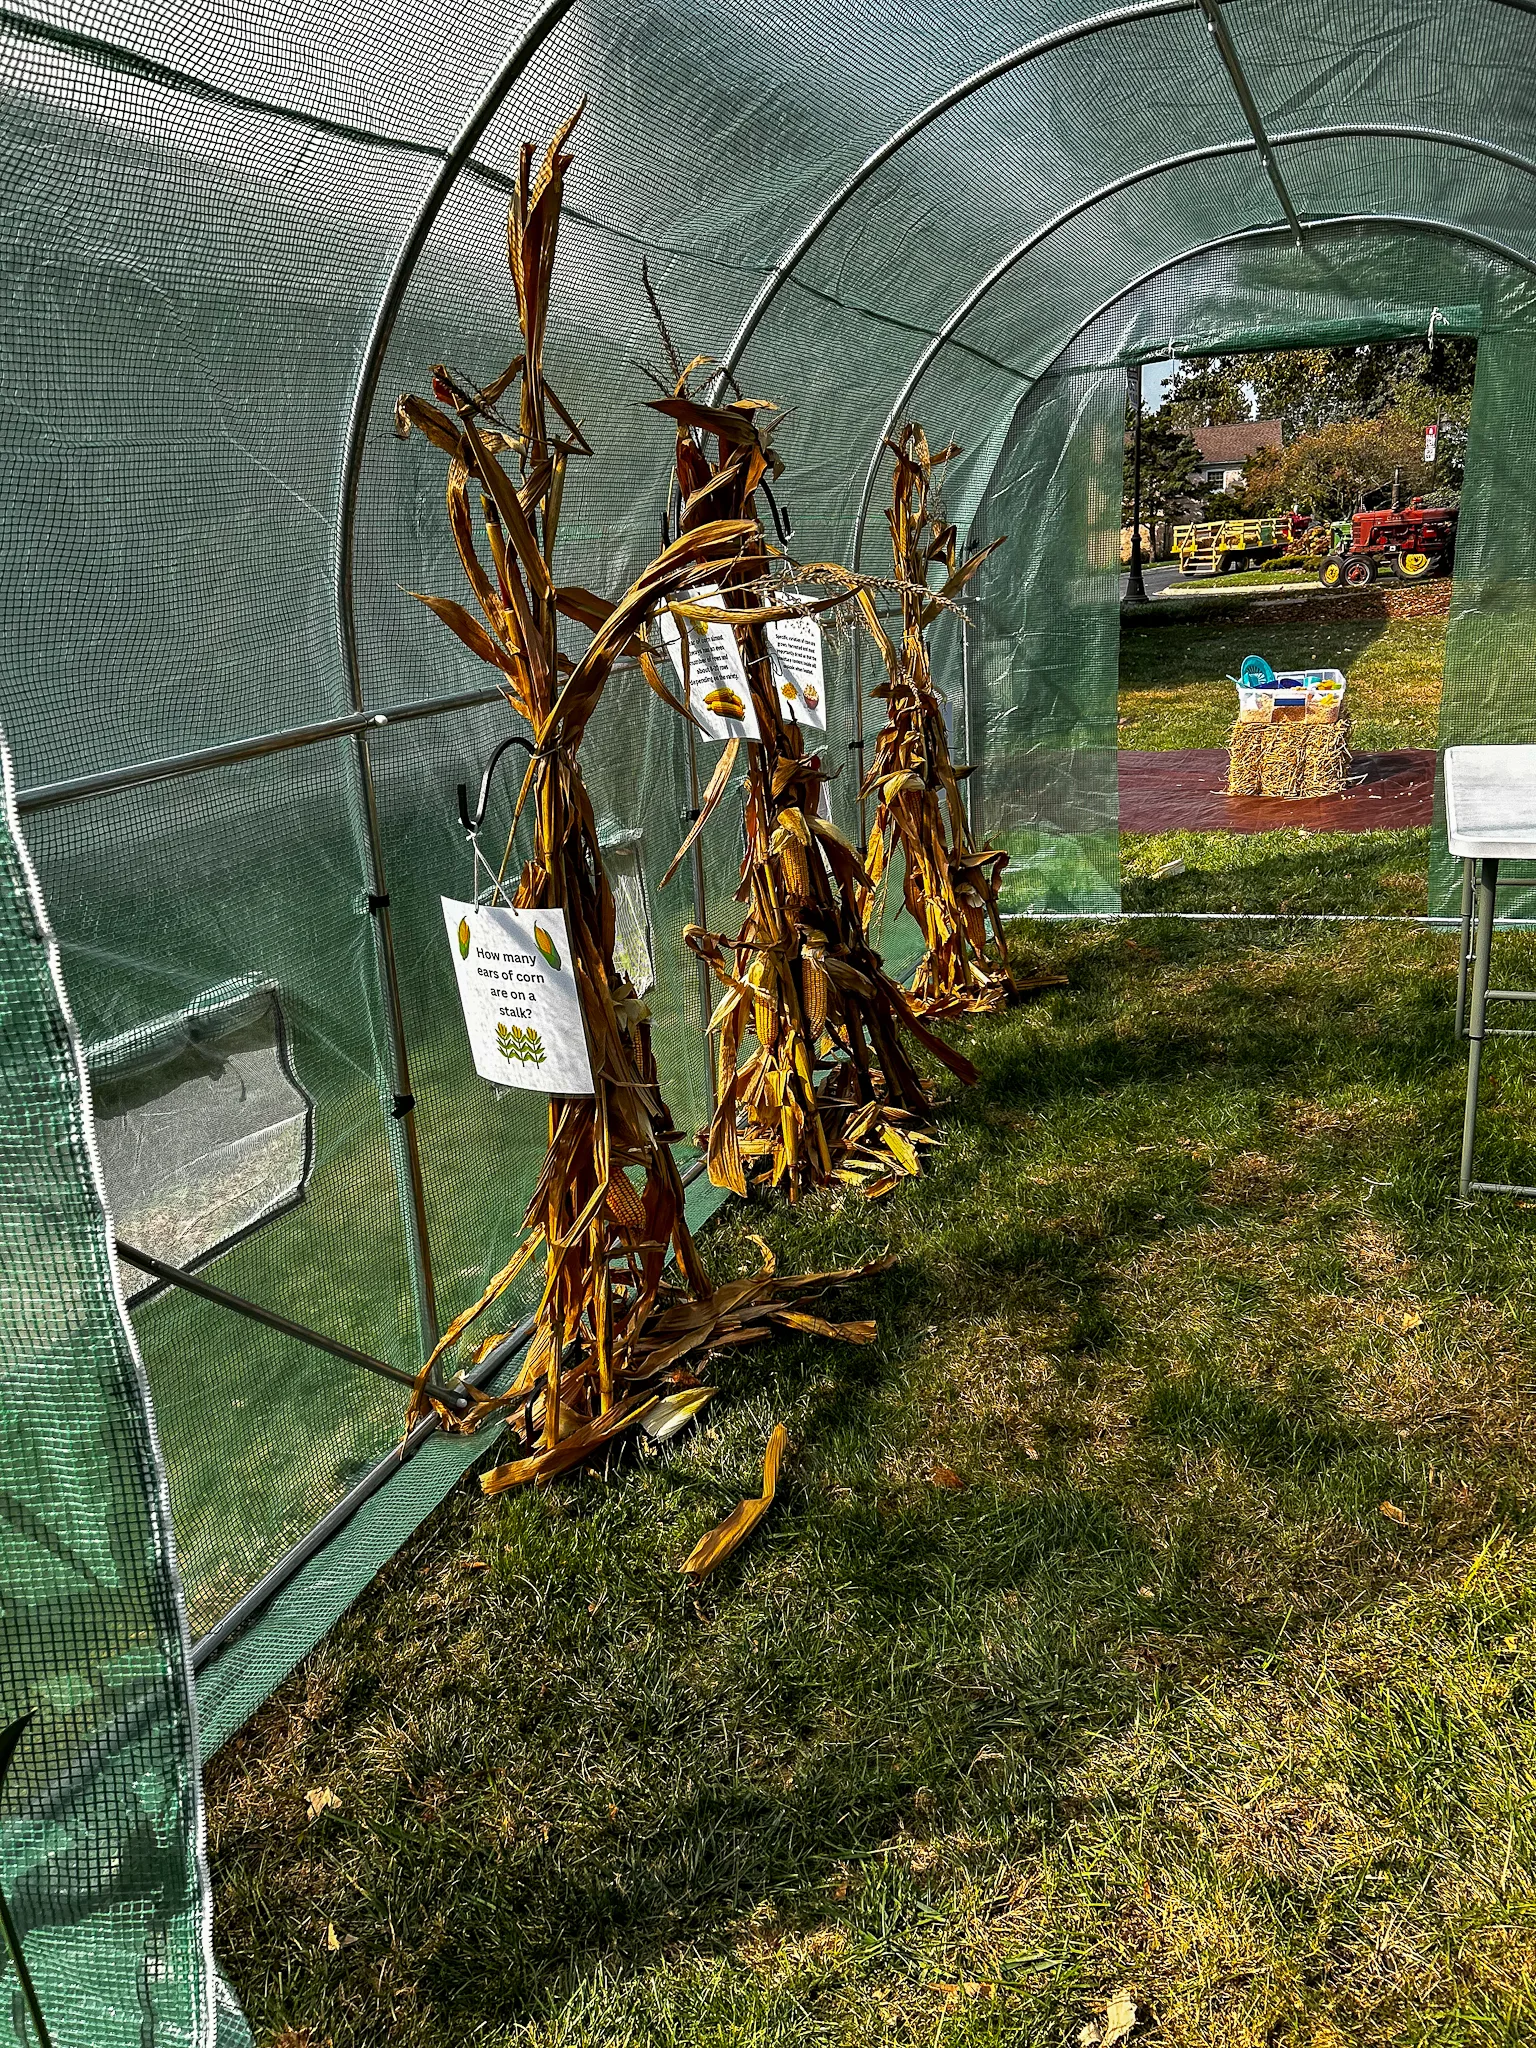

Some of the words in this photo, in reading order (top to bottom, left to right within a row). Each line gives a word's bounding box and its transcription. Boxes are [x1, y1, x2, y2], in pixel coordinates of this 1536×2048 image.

[476, 947, 500, 961] How
[503, 953, 536, 966] many
[478, 968, 499, 978] ears
[502, 970, 513, 981] of
[516, 974, 544, 983] corn
[490, 988, 508, 998] are
[510, 991, 526, 1000] on
[529, 993, 536, 1001] a
[500, 1007, 532, 1018] stalk?
